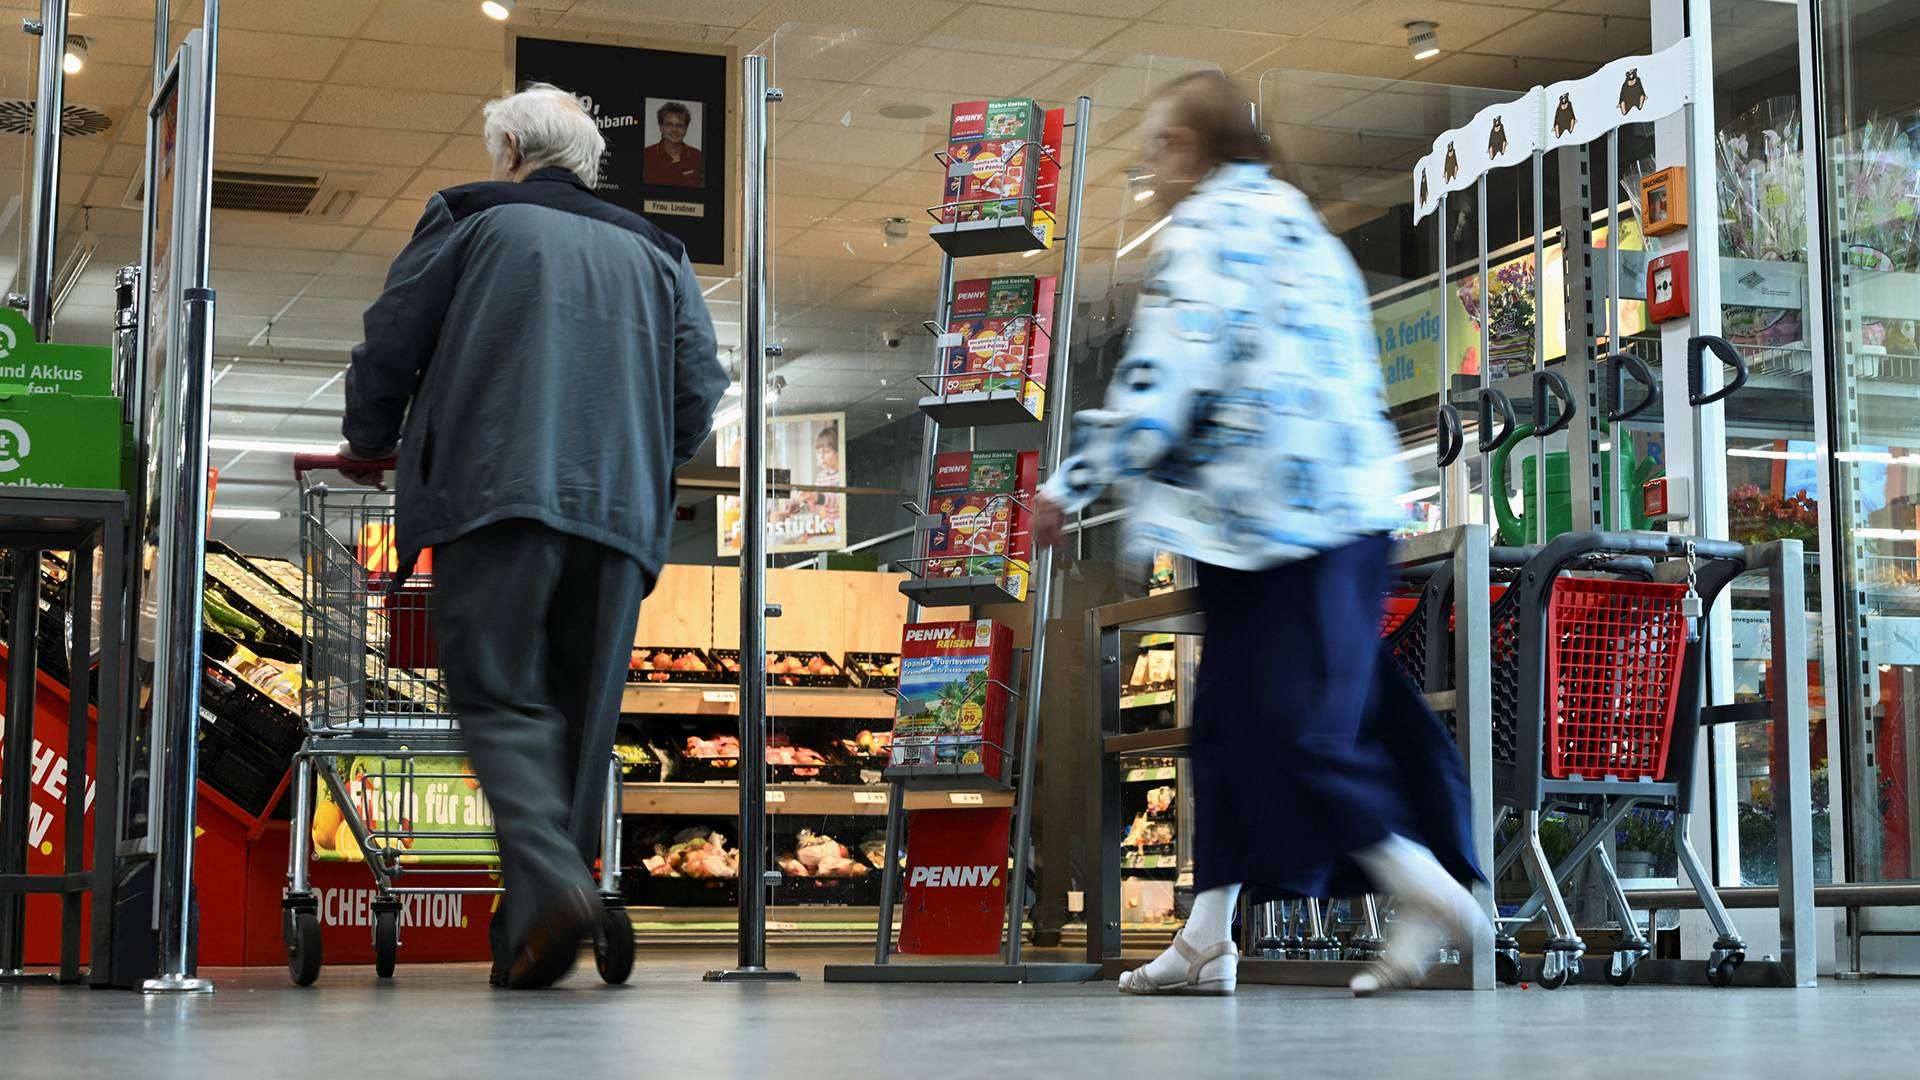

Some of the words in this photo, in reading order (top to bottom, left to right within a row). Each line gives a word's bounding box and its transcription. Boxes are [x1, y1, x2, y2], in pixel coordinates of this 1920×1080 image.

[955, 113, 983, 123] PENNY.
[652, 202, 668, 211] Frau
[670, 203, 697, 213] Lindner
[957, 291, 986, 300] PENNY.
[1399, 310, 1440, 348] fertig
[30, 364, 84, 380] Akkus
[1388, 356, 1422, 385] alle.
[938, 464, 968, 474] PENNY.
[905, 627, 956, 642] PENNY.
[936, 639, 974, 649] REISEN
[937, 657, 986, 666] Fuerteventura
[350, 776, 419, 824] Frisch
[425, 782, 459, 825] für
[909, 865, 1001, 888] PENNY.
